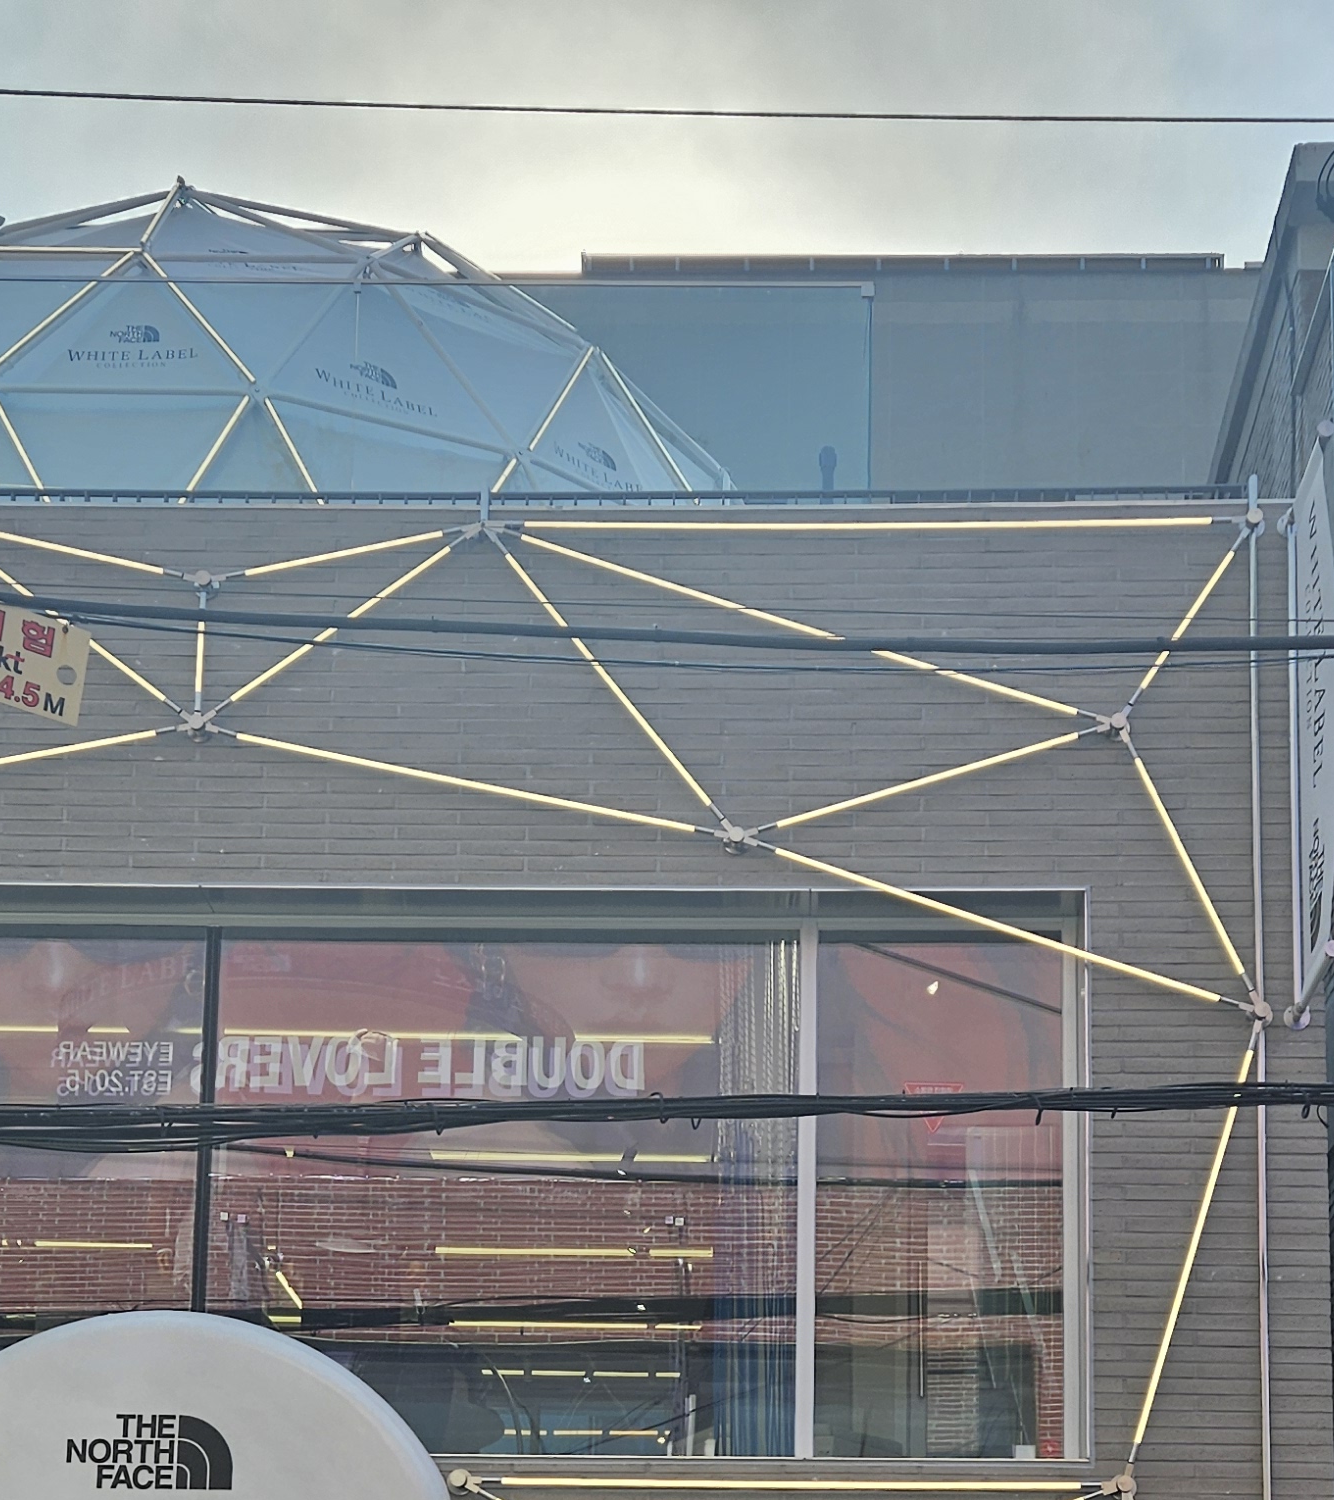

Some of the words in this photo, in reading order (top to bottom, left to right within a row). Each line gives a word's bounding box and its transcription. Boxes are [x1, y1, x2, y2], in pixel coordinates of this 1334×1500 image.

[67, 349, 130, 361] WHITE
[138, 347, 198, 360] LABEL
[116, 1414, 176, 1438] THE
[66, 1438, 174, 1464] NORTH
[95, 1464, 173, 1490] FACE
